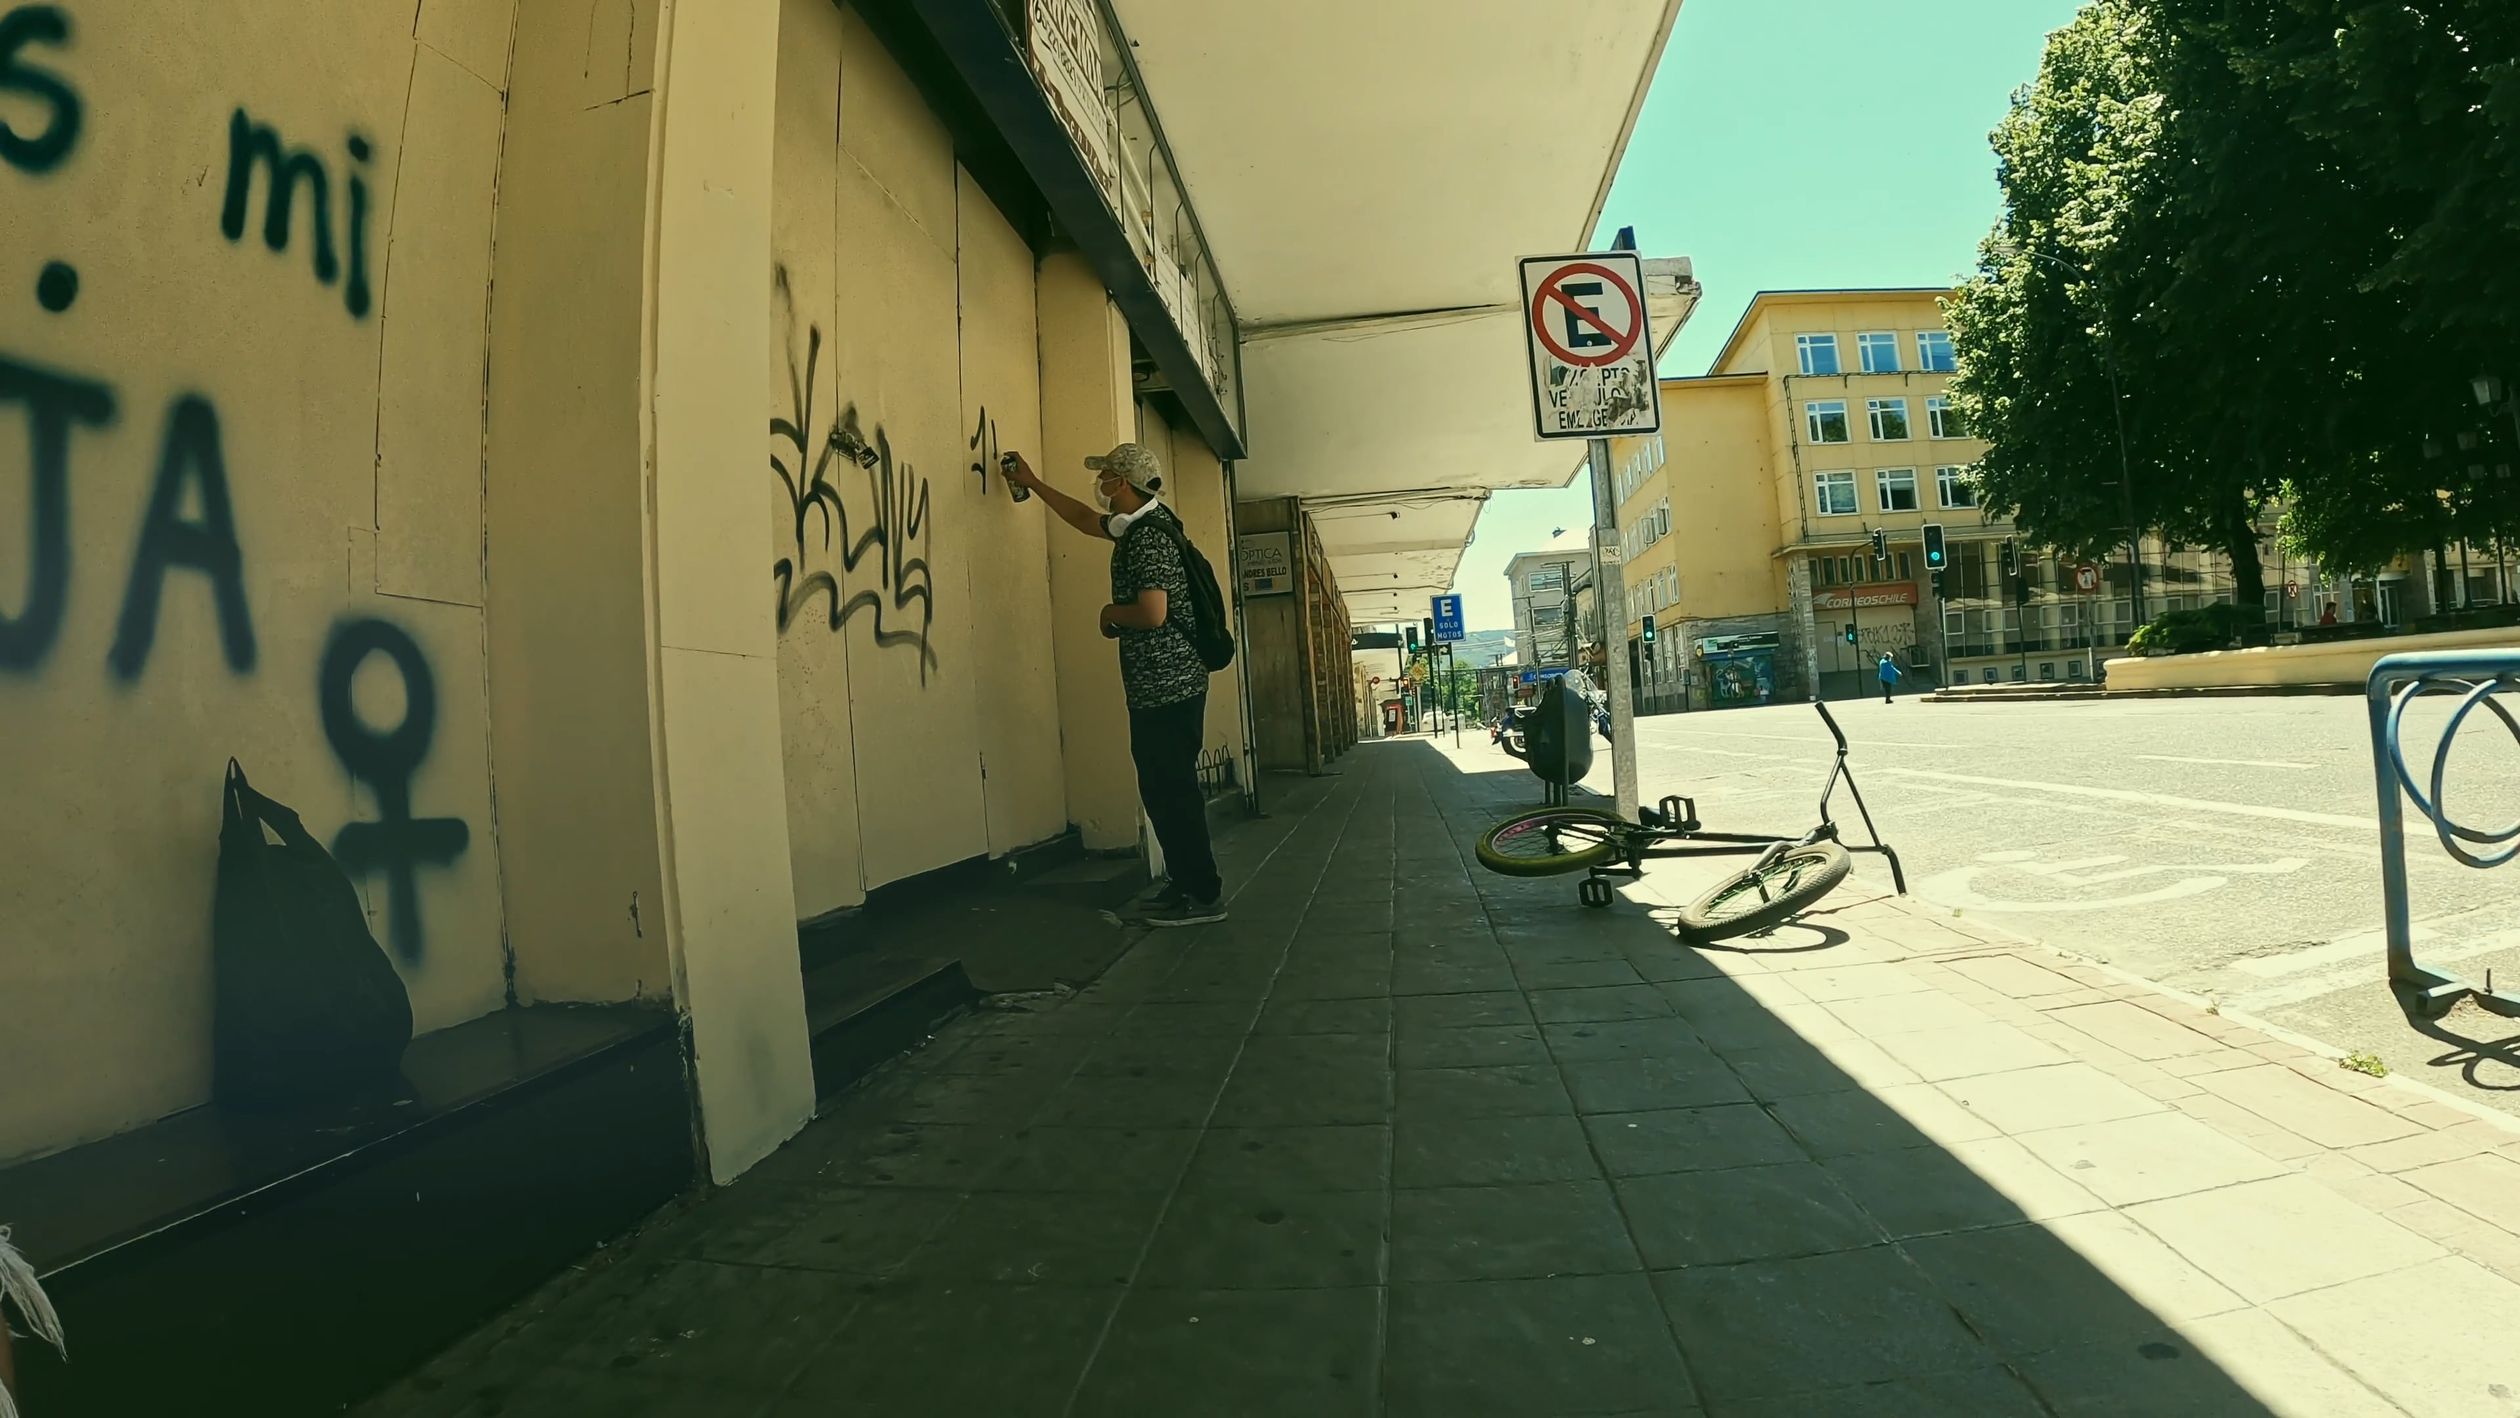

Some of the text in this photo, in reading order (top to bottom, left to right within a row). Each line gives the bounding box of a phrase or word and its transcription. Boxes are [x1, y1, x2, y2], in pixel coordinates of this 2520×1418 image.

[1041, 0, 1106, 106] IENDA
[221, 107, 371, 318] mi
[1561, 282, 1612, 348] E
[1266, 566, 1287, 577] BELLO
[1441, 599, 1453, 617] E
[1440, 621, 1459, 629] SOLO
[1437, 630, 1462, 640] MOTOS
